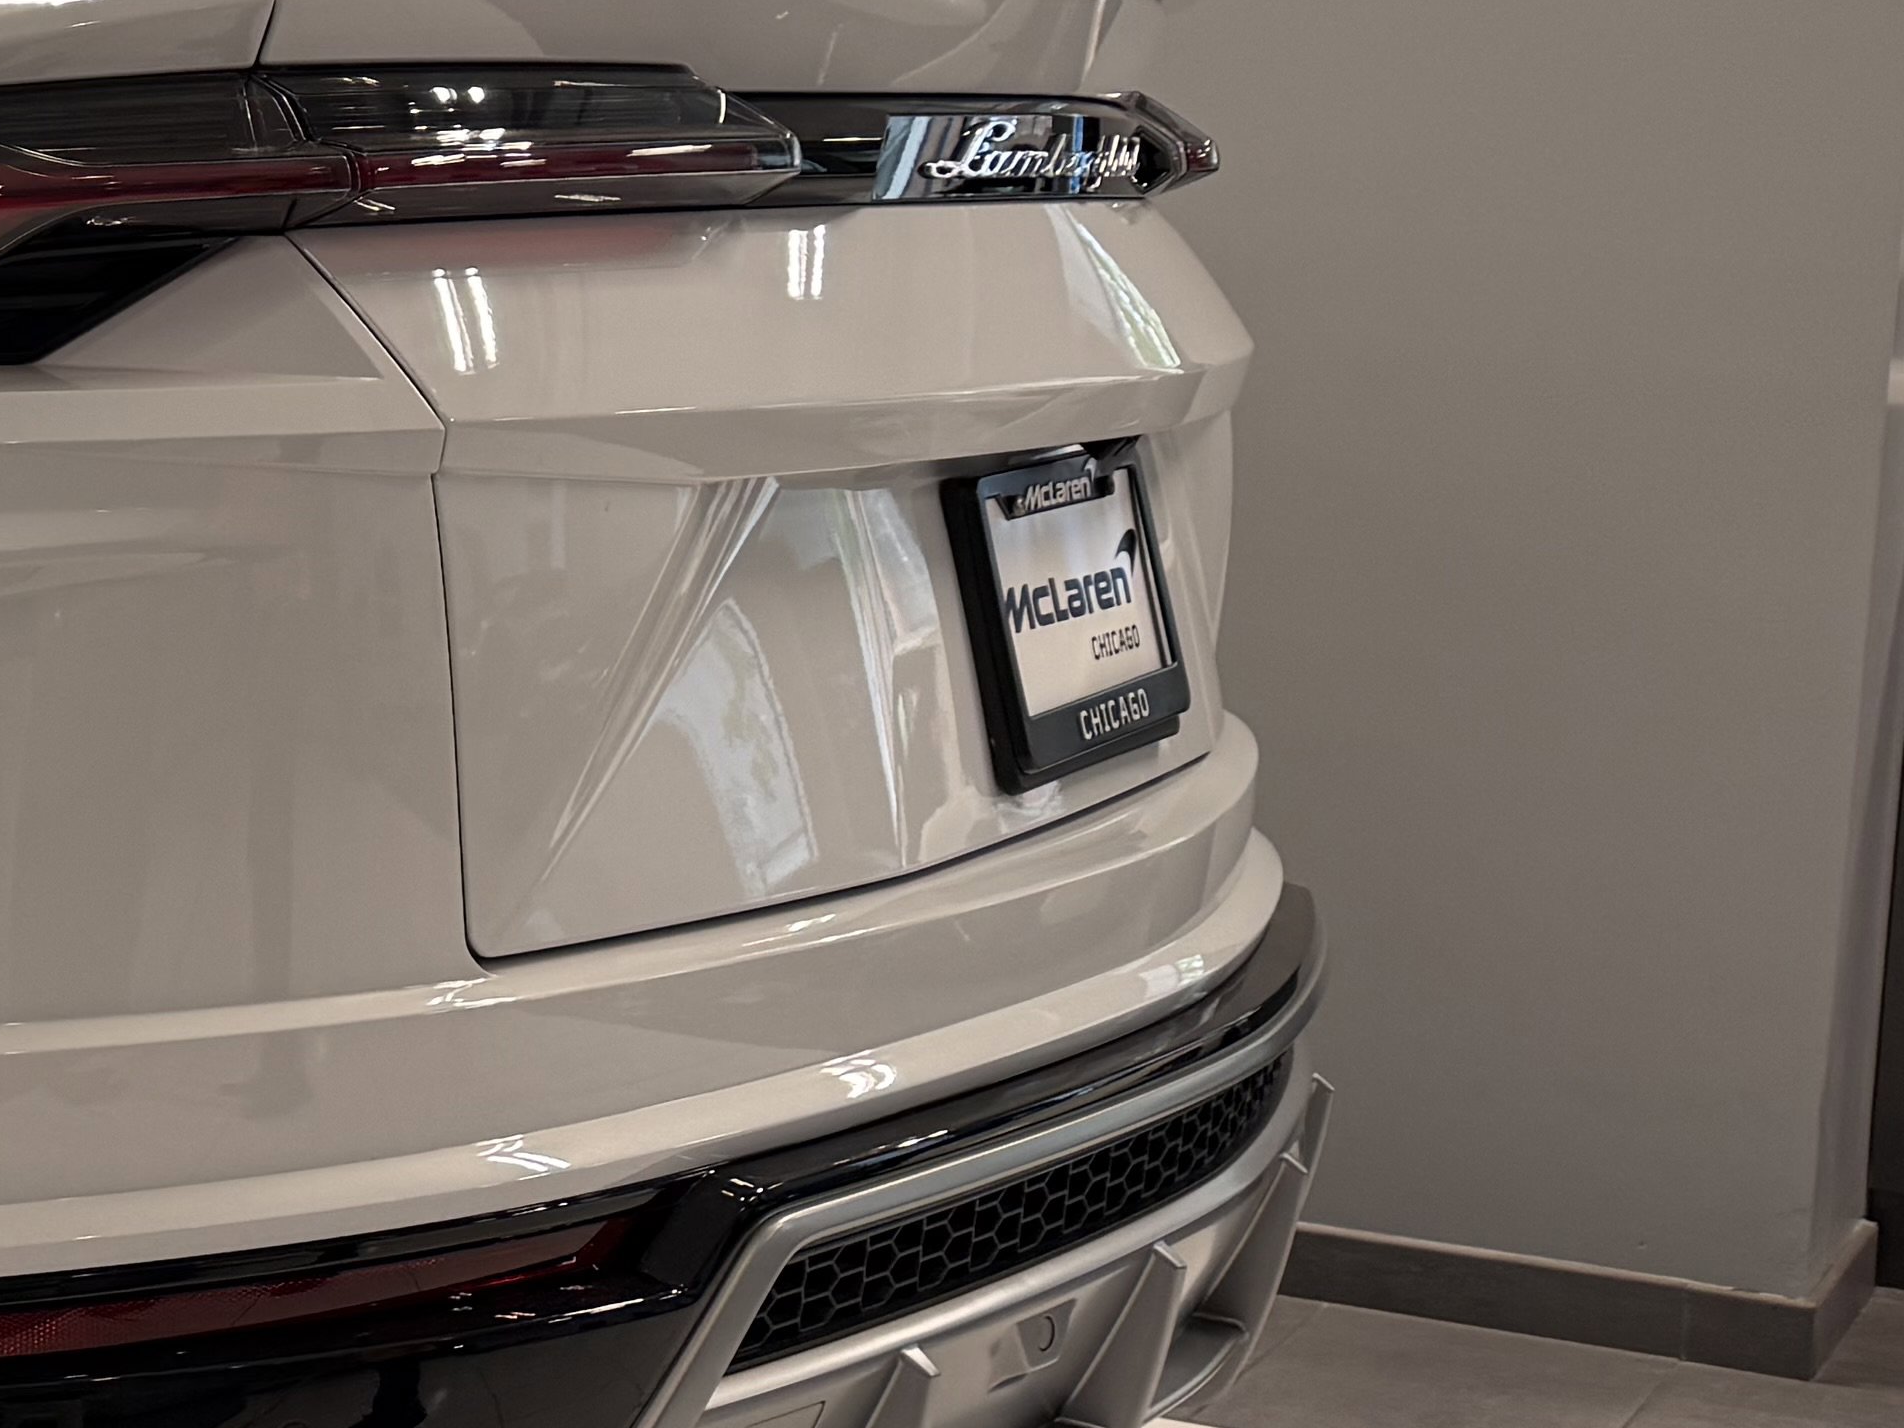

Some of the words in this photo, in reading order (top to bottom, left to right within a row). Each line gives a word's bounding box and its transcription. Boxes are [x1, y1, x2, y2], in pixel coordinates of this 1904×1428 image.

[1024, 476, 1091, 513] McLaren
[1004, 566, 1132, 634] McLaren
[1090, 624, 1141, 661] CHICAGO
[1078, 688, 1150, 741] CHICAGO
